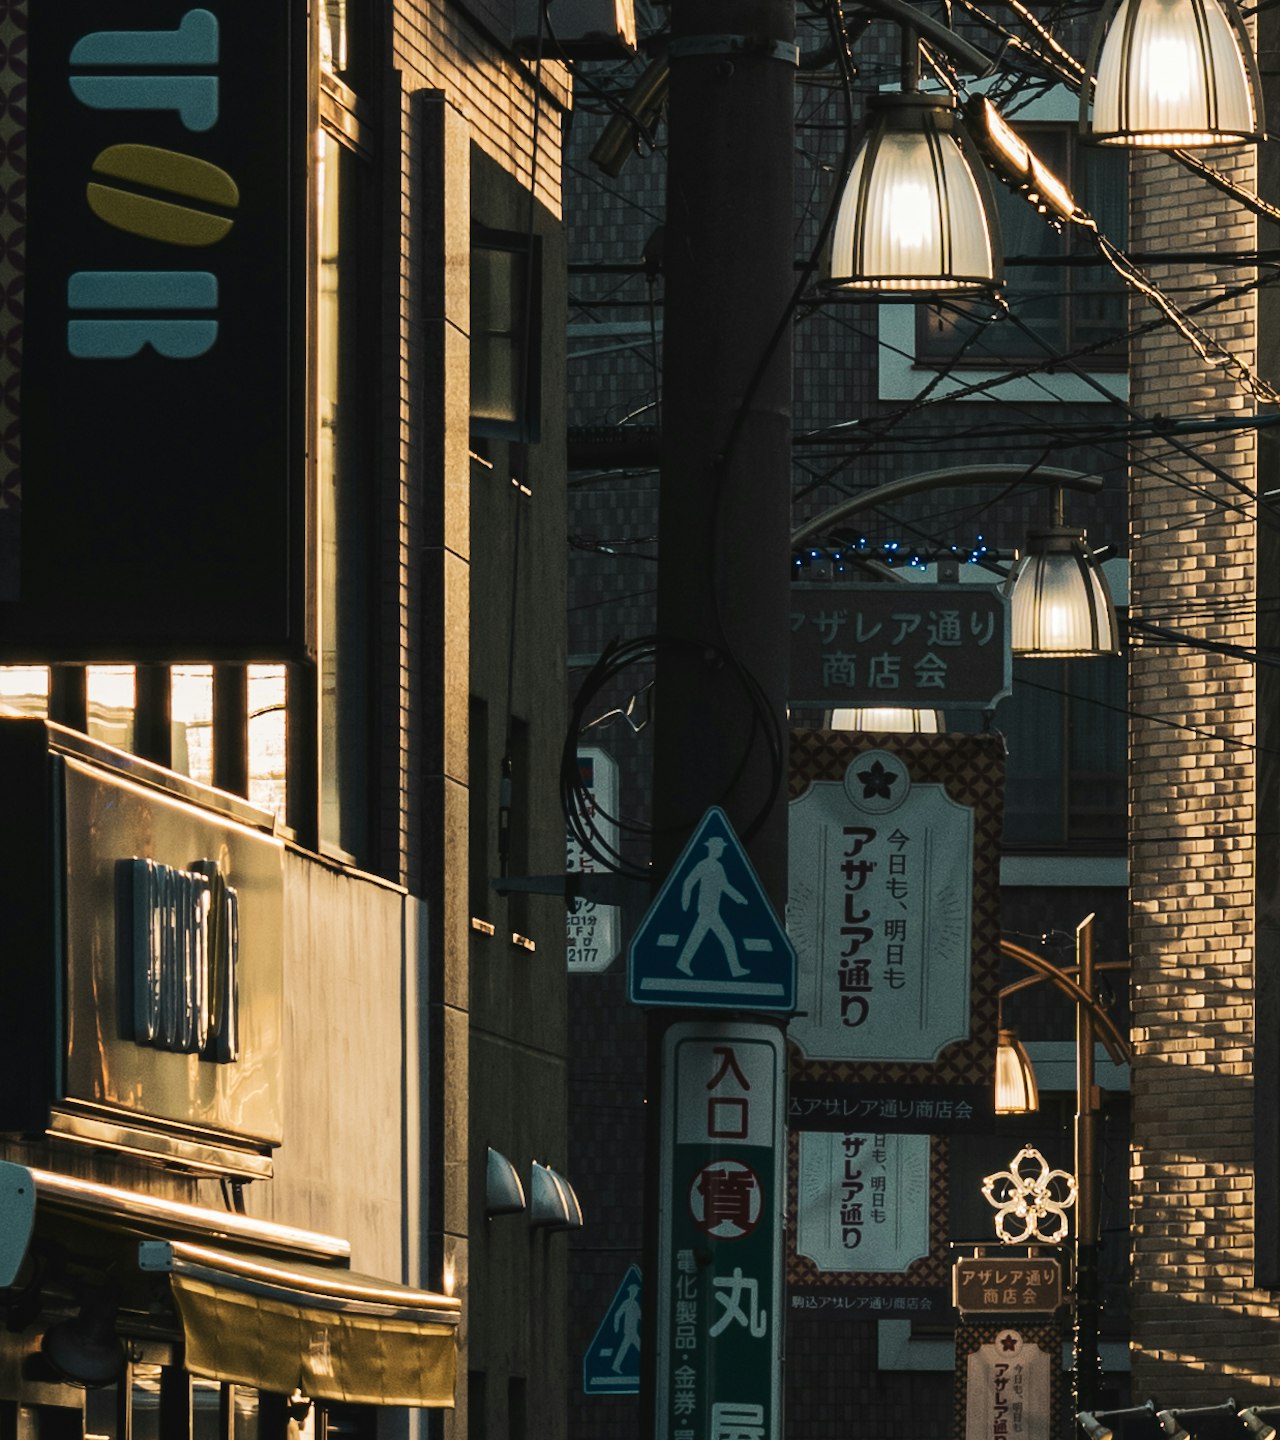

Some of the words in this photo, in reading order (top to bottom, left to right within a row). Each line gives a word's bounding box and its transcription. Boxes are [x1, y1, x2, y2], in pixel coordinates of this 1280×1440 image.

[823, 652, 948, 688] 商店会
[838, 826, 878, 1027] アザレア通り
[883, 828, 910, 990] 今日も、明日も
[706, 1046, 749, 1140] 入口
[696, 1164, 755, 1226] 質
[961, 1271, 1056, 1287] アザレア通り
[983, 1289, 1038, 1306] 商店会
